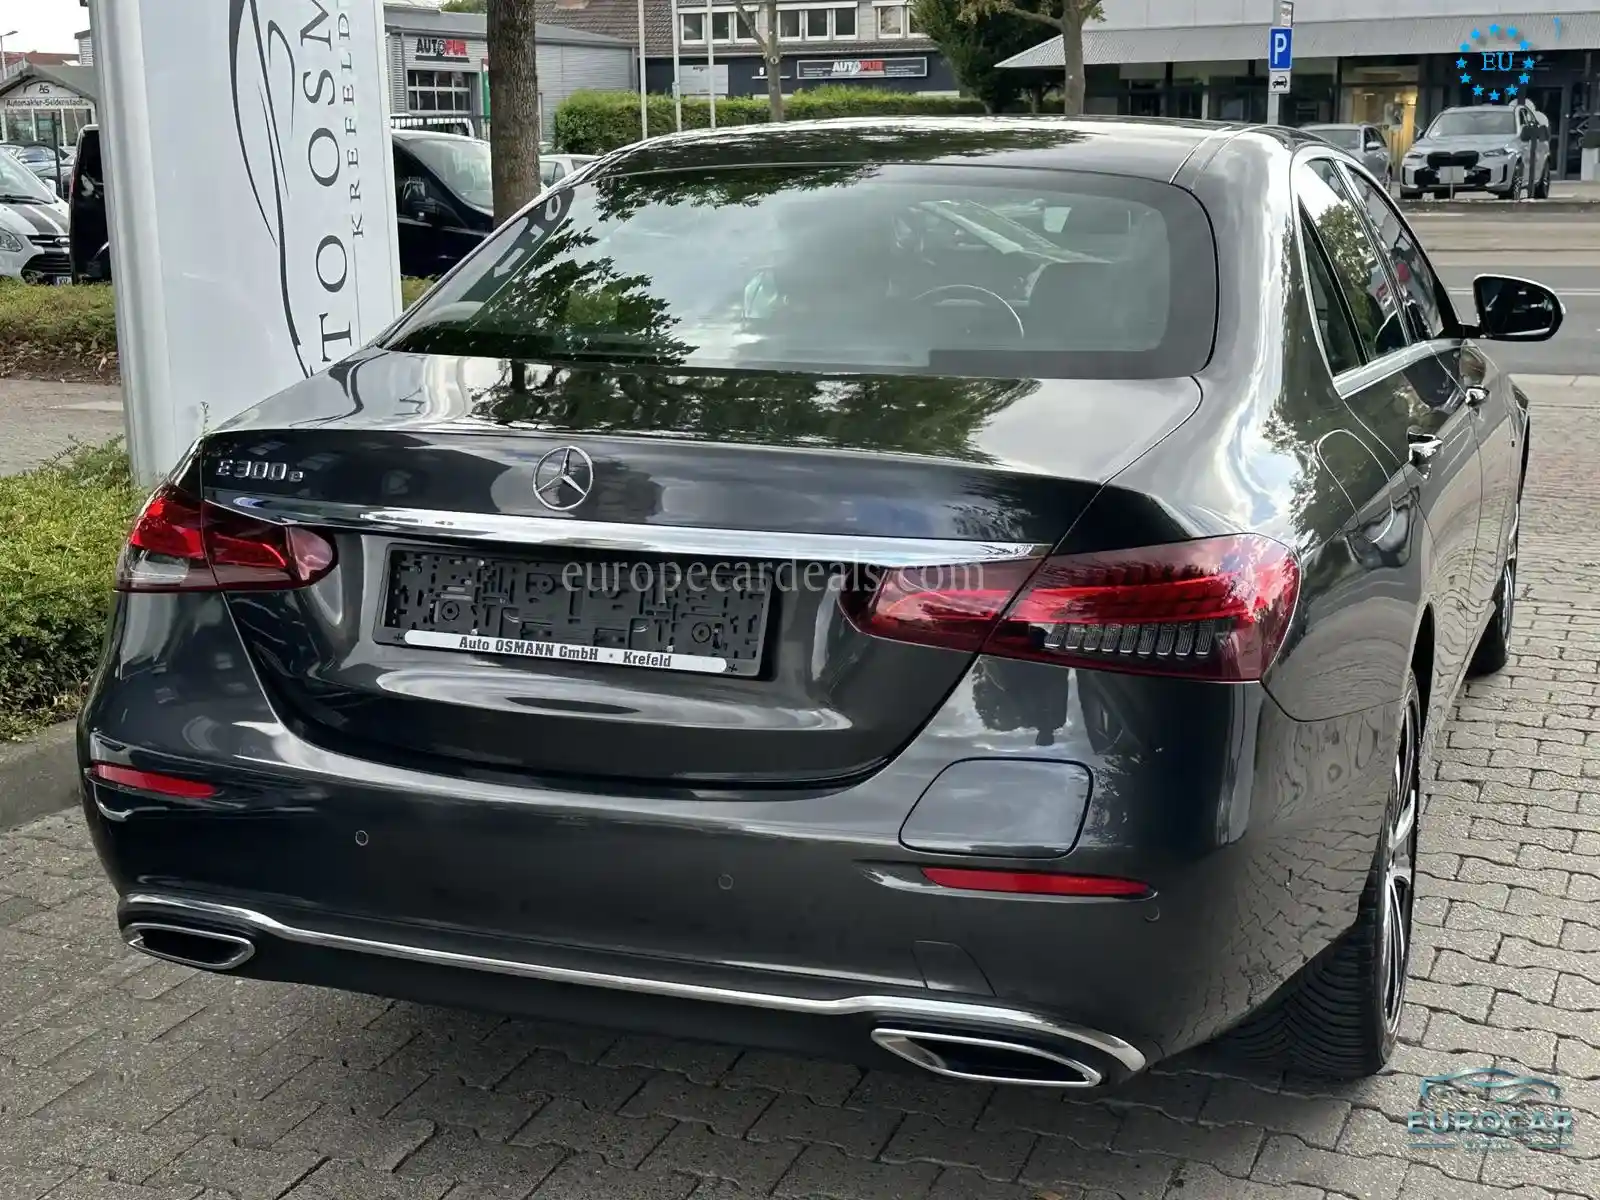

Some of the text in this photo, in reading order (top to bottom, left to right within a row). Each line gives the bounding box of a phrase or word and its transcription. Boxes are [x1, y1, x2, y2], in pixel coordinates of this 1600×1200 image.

[1274, 33, 1287, 65] P
[337, 12, 364, 238] KREFELD
[460, 636, 672, 667] Auto OSMANN GmbH Krefeld
